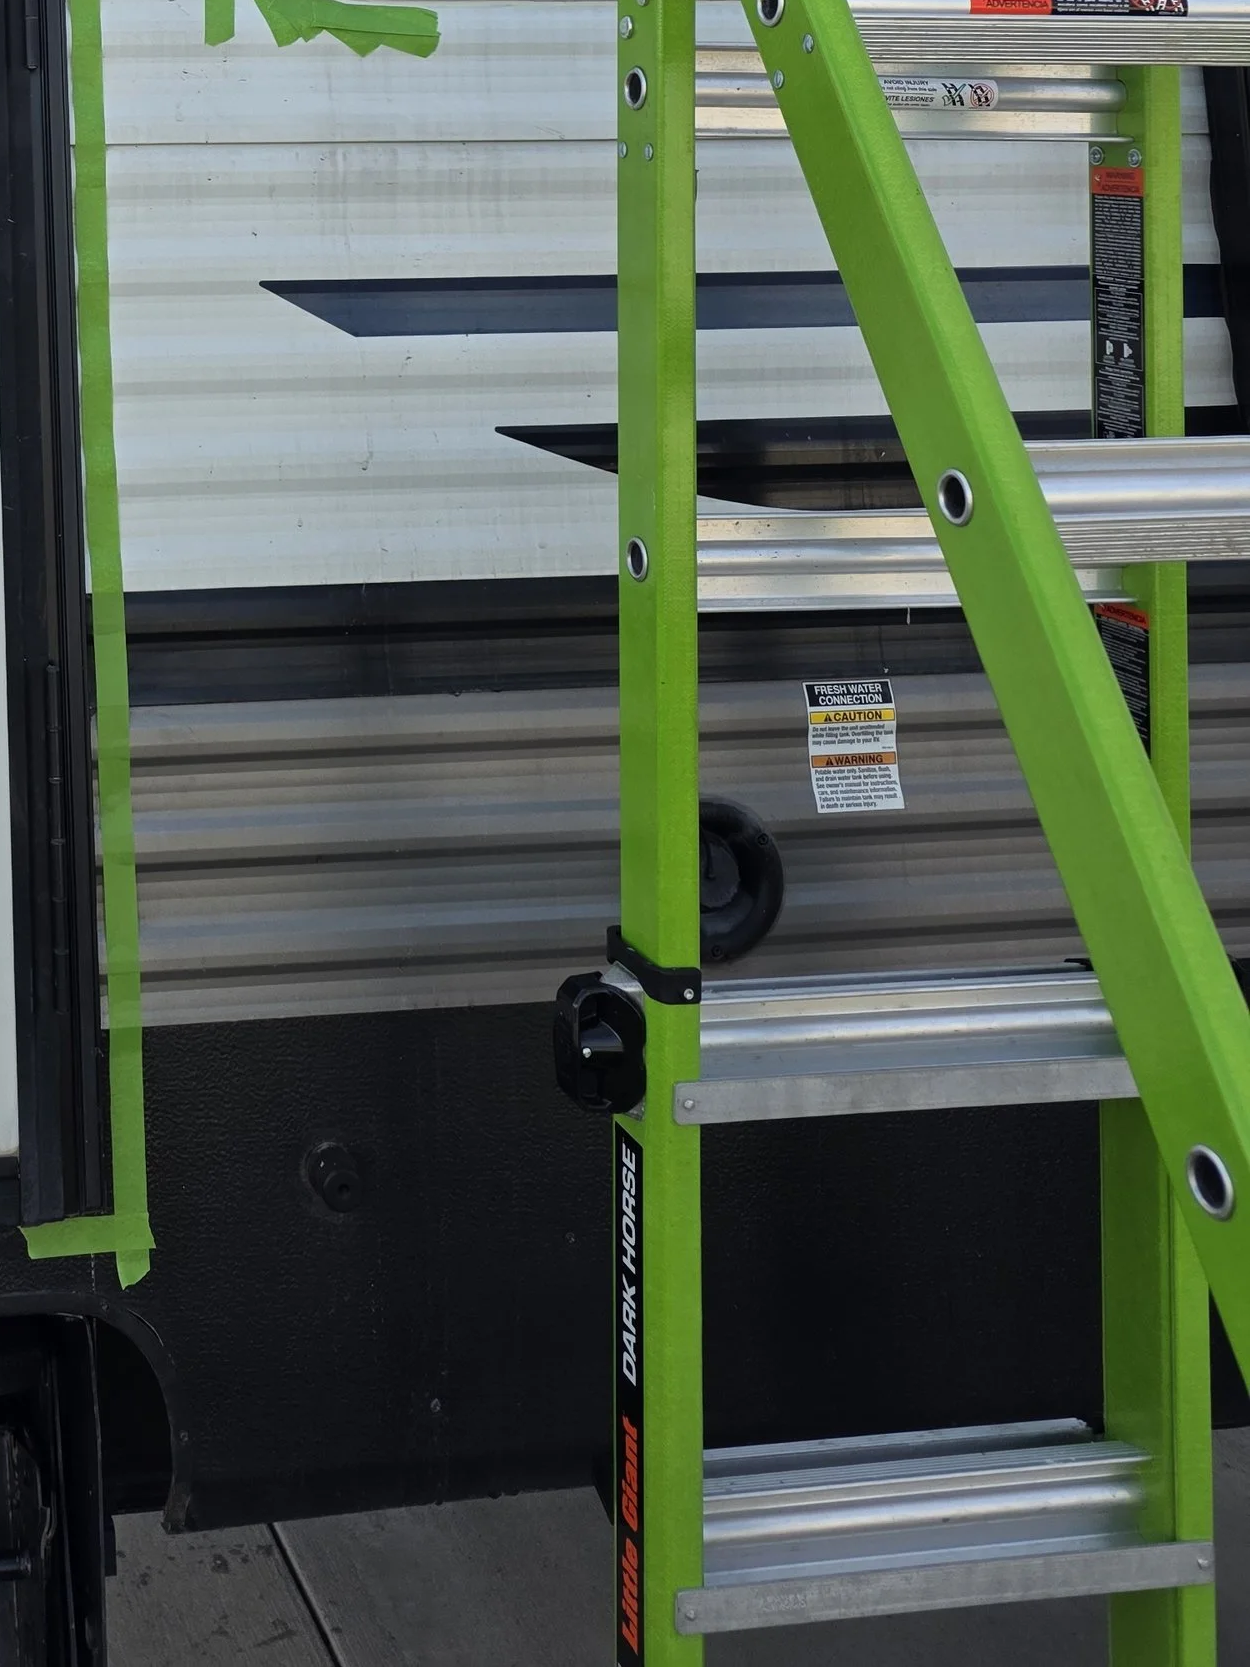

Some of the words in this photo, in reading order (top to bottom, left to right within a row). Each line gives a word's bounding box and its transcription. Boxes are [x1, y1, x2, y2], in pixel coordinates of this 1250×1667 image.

[986, 0, 1049, 8] ADVERTENCIA
[814, 684, 847, 695] FRESH
[848, 683, 883, 694] WATER
[819, 694, 883, 705] CONNECTION
[834, 711, 882, 721] CAUTION
[835, 755, 883, 765] WARNING
[622, 1143, 636, 1275] HORSE
[622, 1273, 636, 1386] DARK
[622, 1414, 638, 1532] Giant
[622, 1538, 638, 1656] Little
